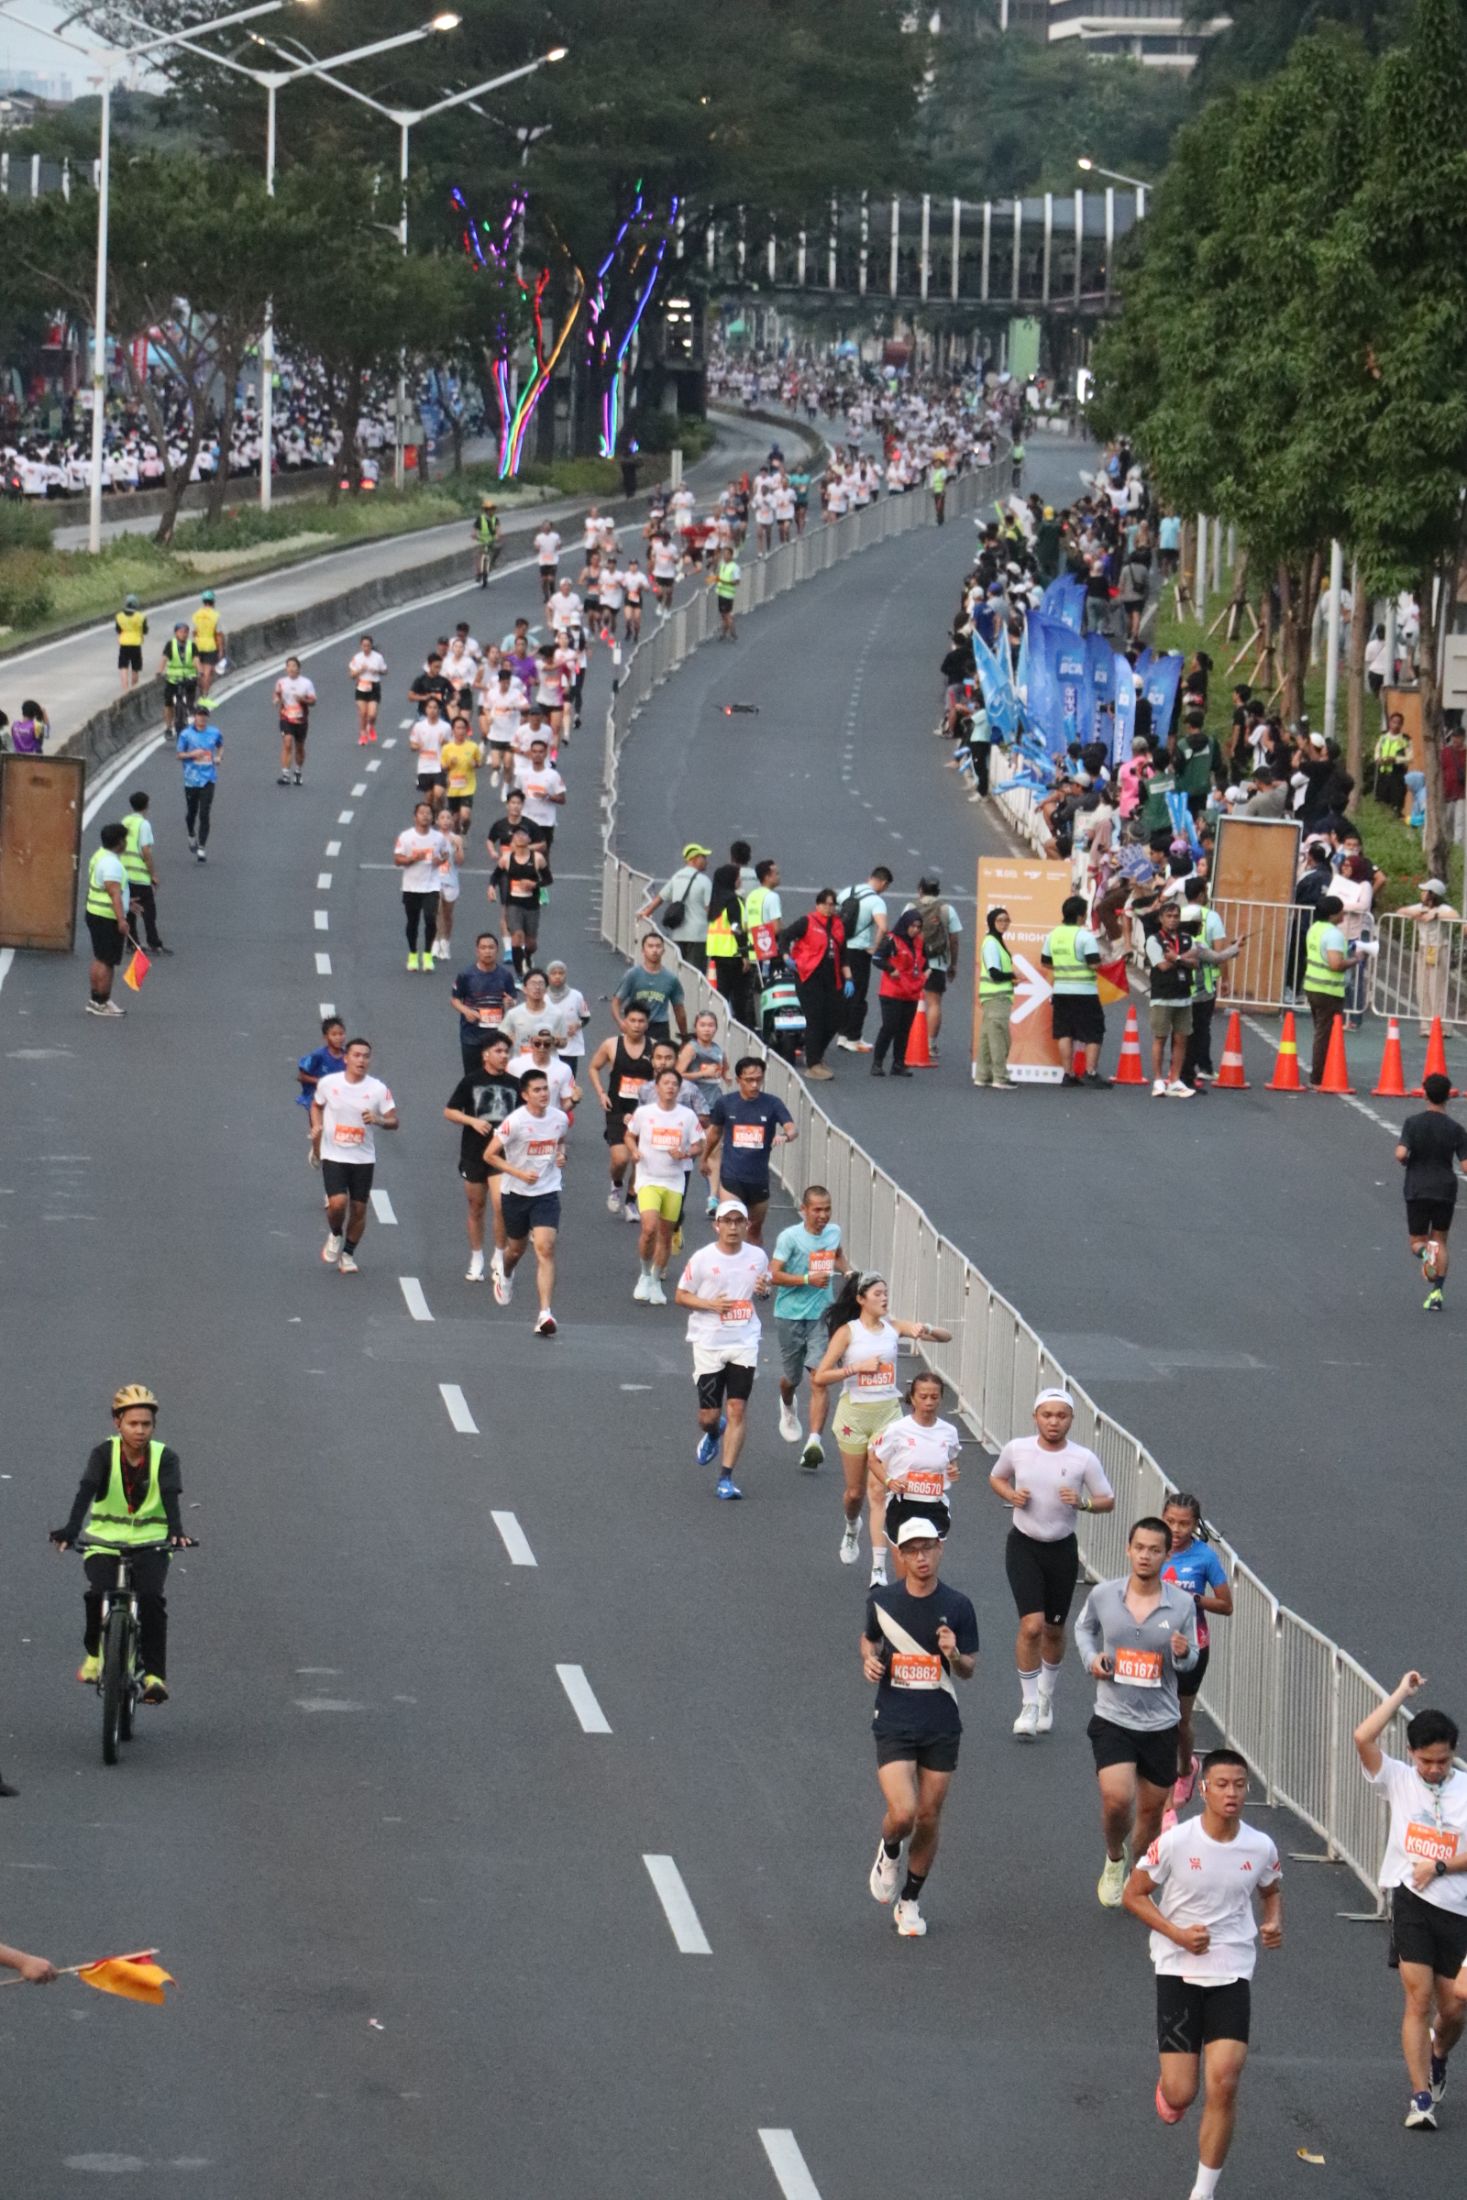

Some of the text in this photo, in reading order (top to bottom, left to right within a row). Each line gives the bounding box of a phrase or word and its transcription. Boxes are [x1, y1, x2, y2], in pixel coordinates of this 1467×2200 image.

[907, 1480, 941, 1494] R60570
[894, 1665, 938, 1680] K63862
[1119, 1660, 1159, 1678] K61673
[1407, 1836, 1453, 1860] K60039
